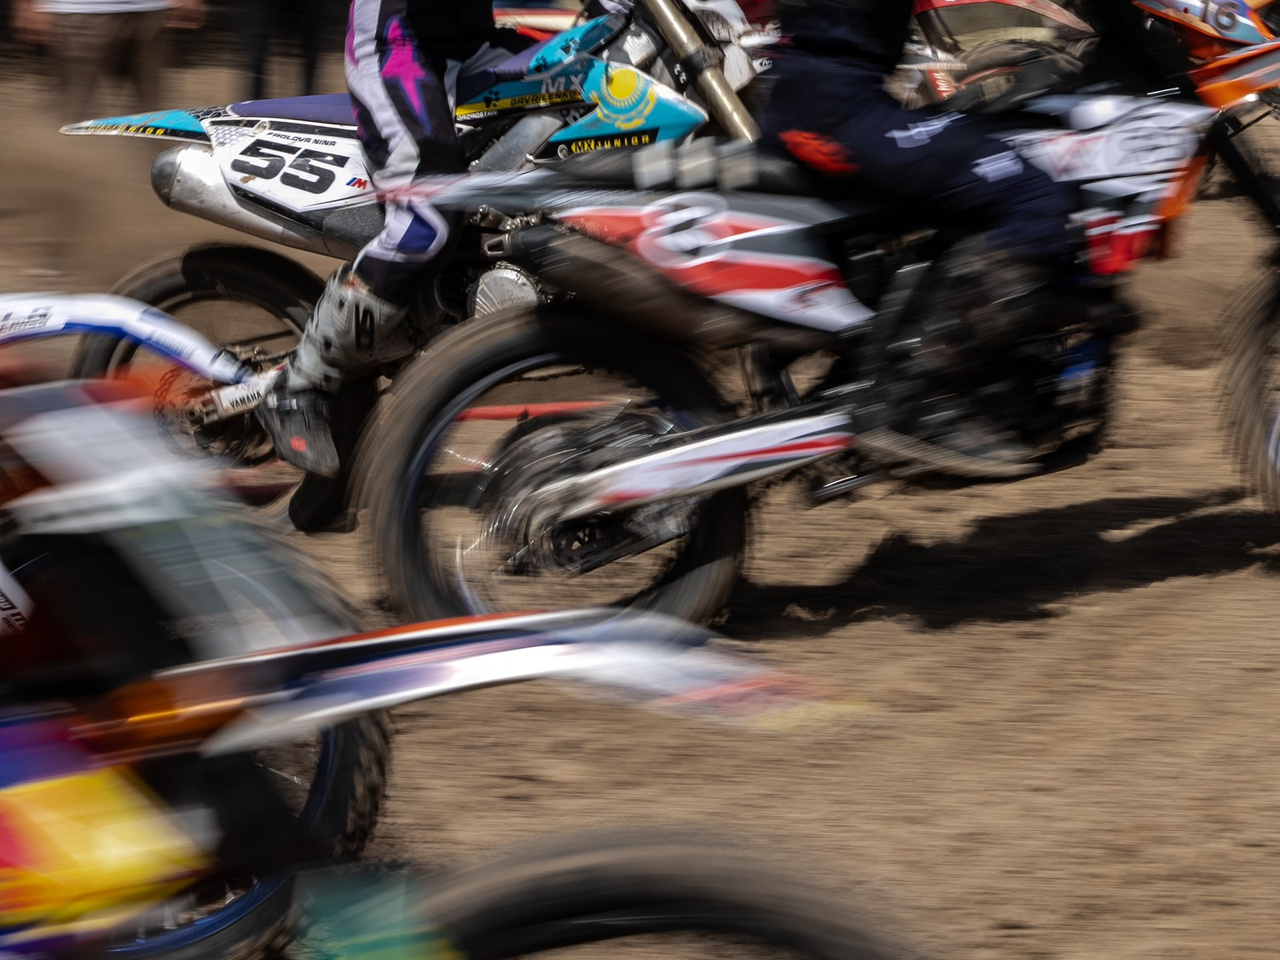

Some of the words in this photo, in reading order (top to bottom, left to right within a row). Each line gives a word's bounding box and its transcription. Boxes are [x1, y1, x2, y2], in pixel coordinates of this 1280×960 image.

[541, 73, 586, 94] MX
[230, 139, 350, 195] 55
[229, 390, 262, 410] YAMAHA
